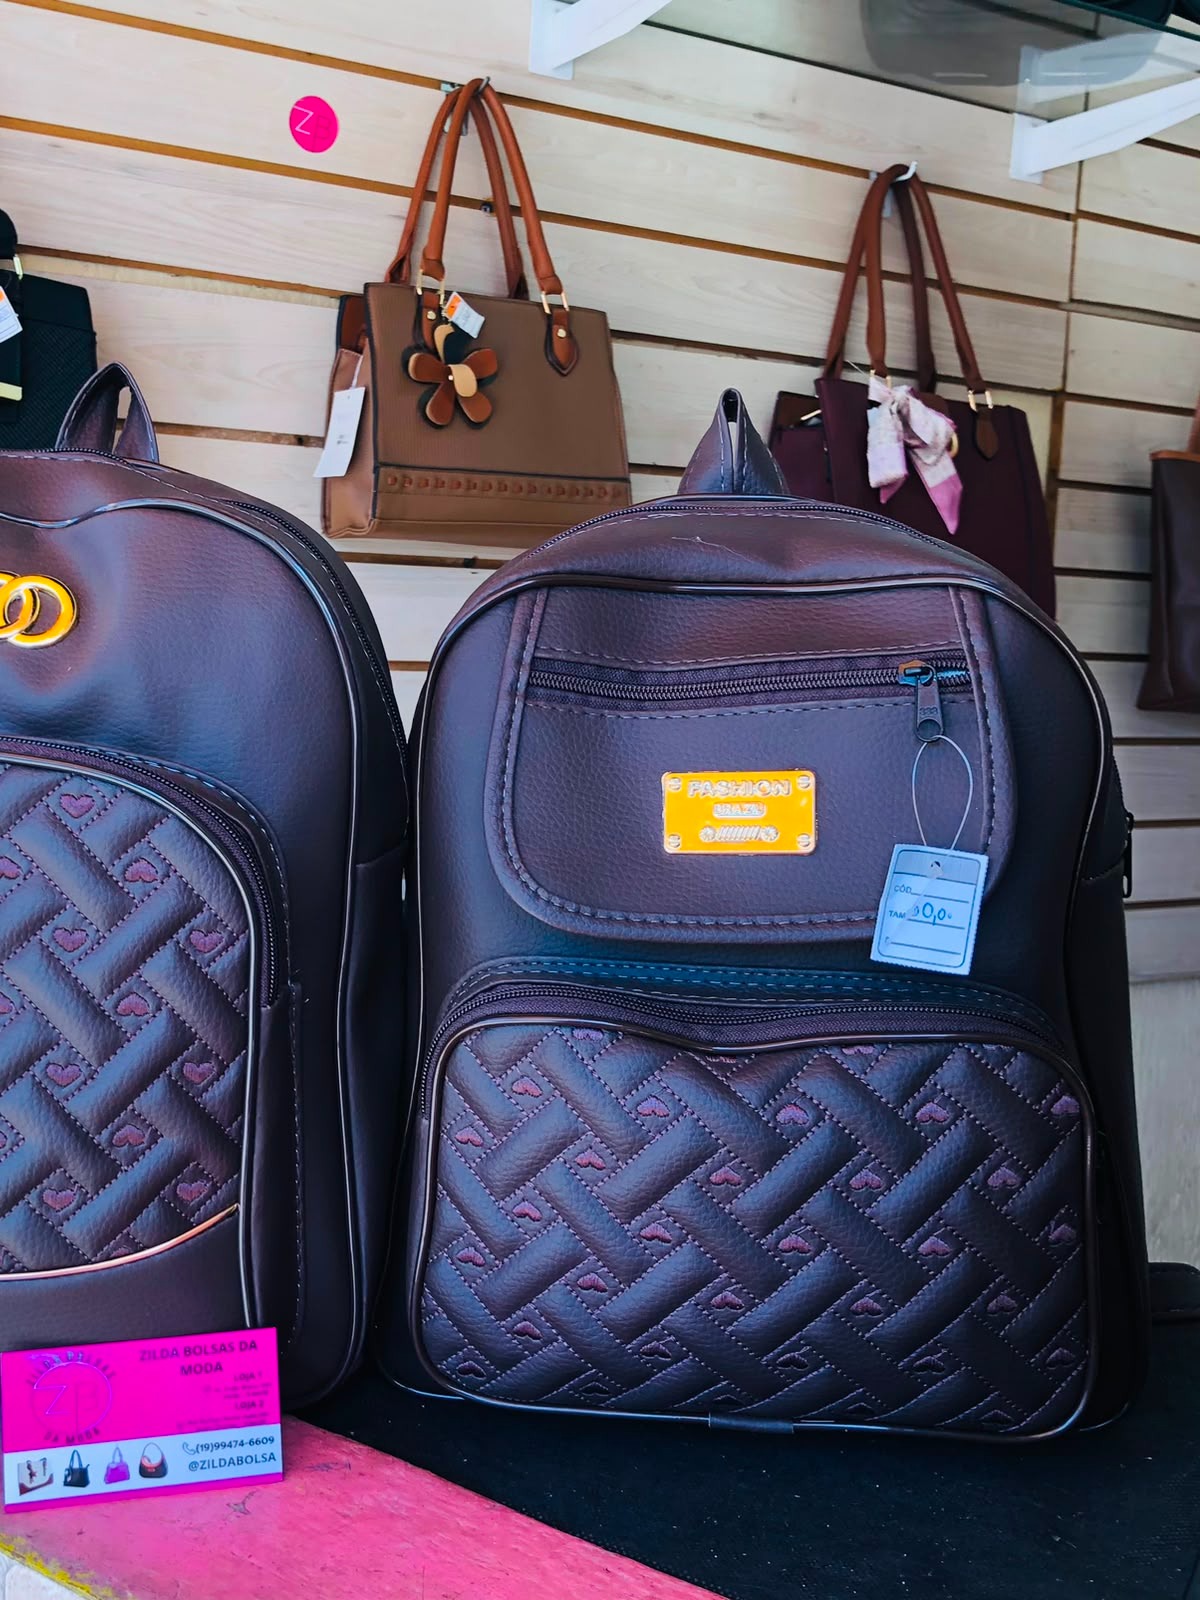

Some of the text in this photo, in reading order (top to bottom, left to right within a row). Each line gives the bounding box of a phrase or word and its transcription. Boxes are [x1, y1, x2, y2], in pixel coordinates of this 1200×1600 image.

[687, 779, 792, 798] FASHION
[888, 909, 906, 919] TAM
[139, 1340, 258, 1362] ZILDA BOLSAS DA
[181, 1361, 223, 1376] MODA
[195, 1436, 275, 1455] (19)99474-6609
[188, 1451, 277, 1473] @ZILDABOLSA
